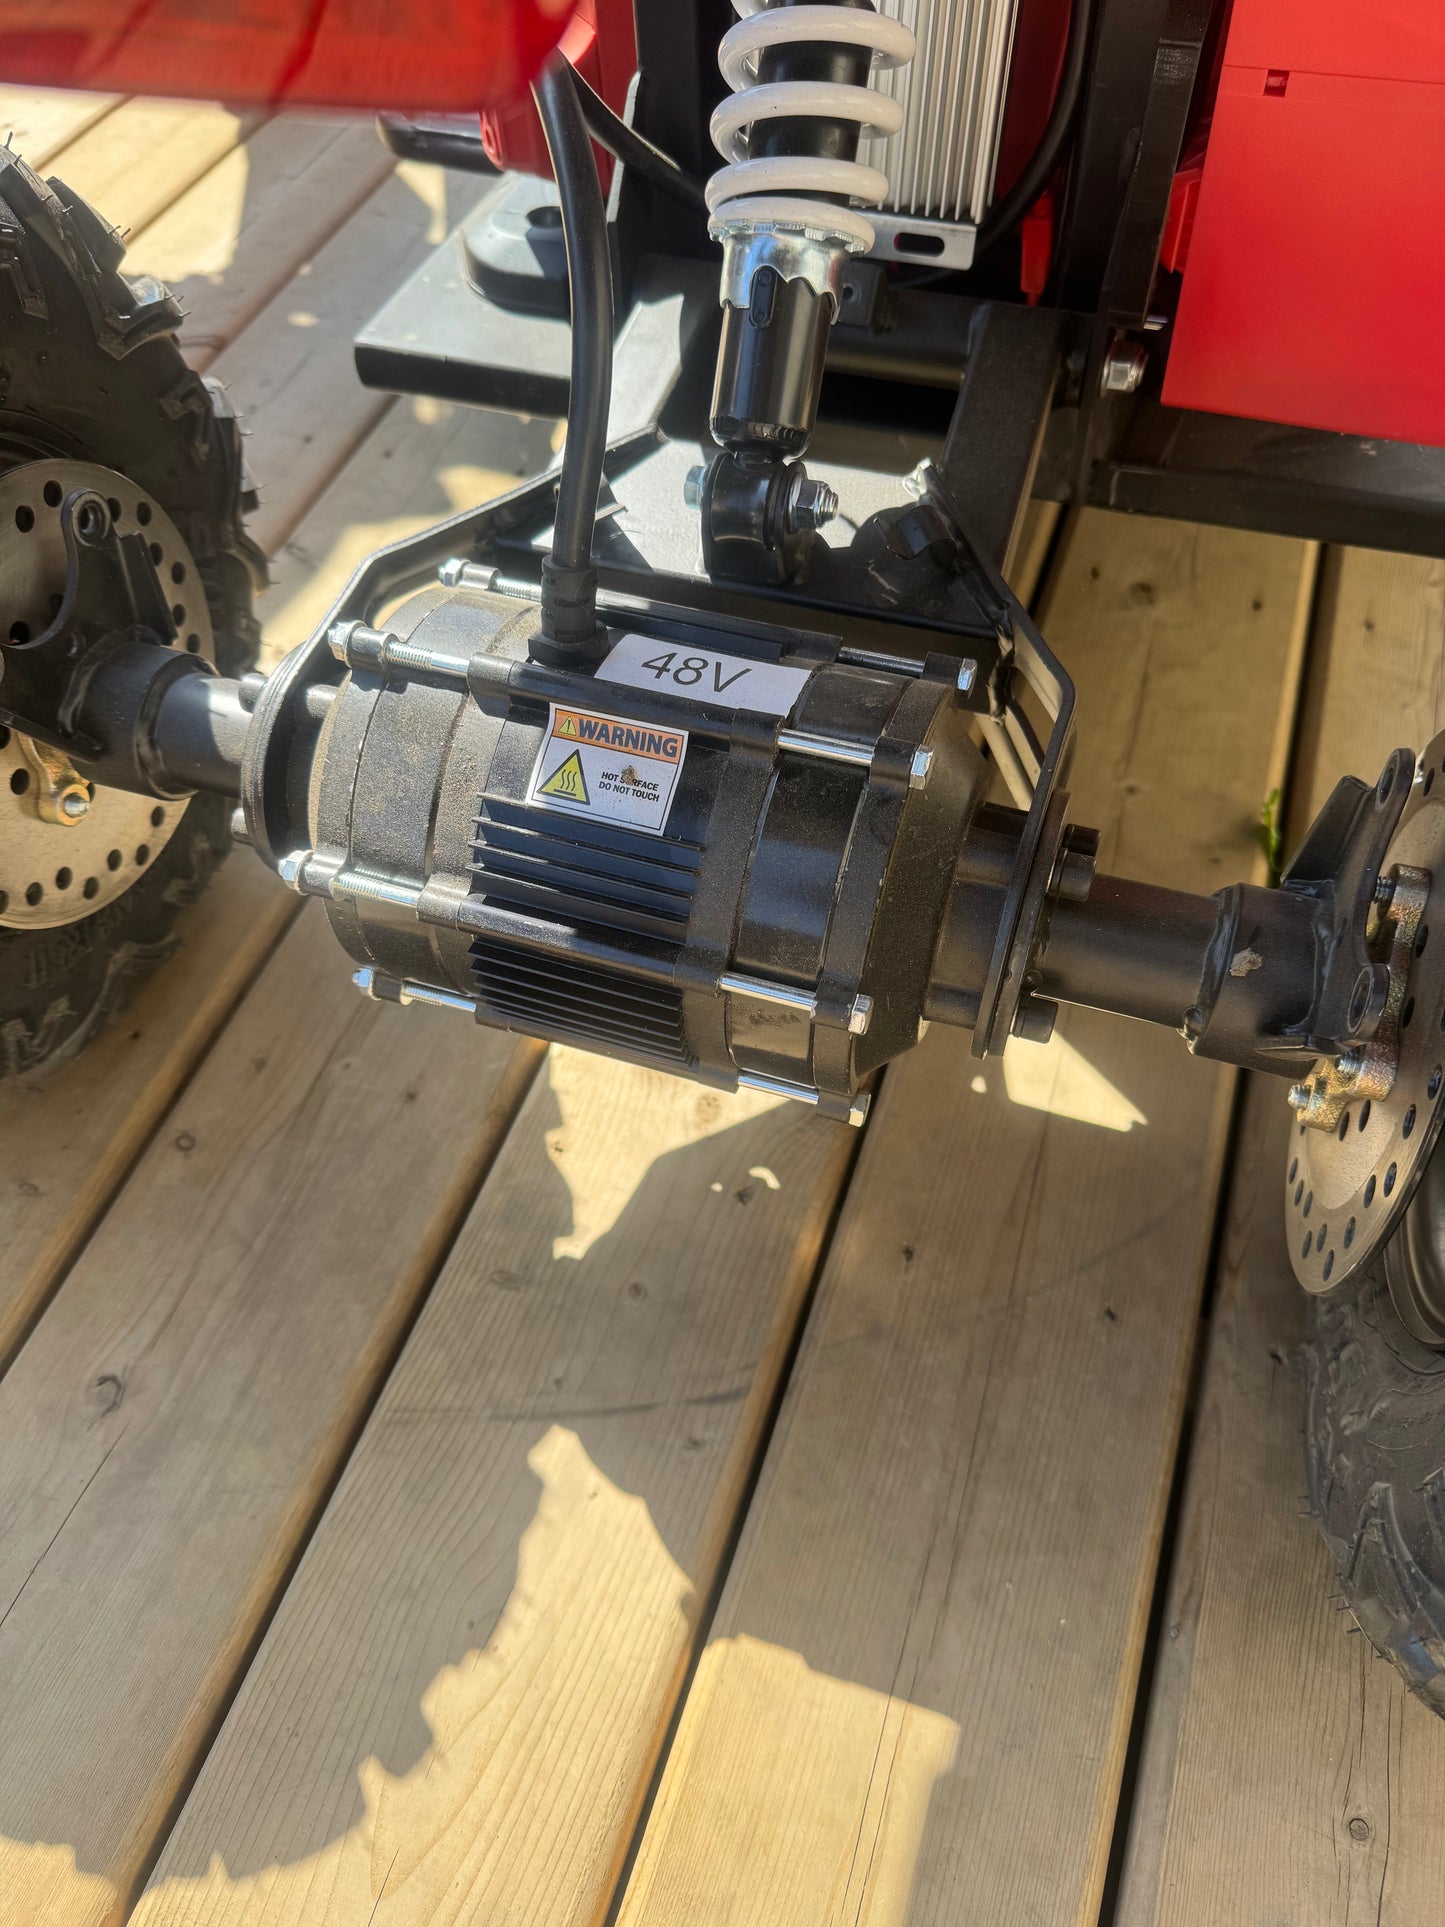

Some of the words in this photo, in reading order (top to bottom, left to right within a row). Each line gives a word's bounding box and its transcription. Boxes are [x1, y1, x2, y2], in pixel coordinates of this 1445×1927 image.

[641, 652, 752, 692] 48V
[578, 718, 678, 758] WARNING
[598, 781, 611, 790] DO
[612, 784, 630, 795] NOT
[632, 788, 660, 802] TOUCH
[601, 771, 619, 782] HOT
[619, 775, 659, 791] SRFACE
